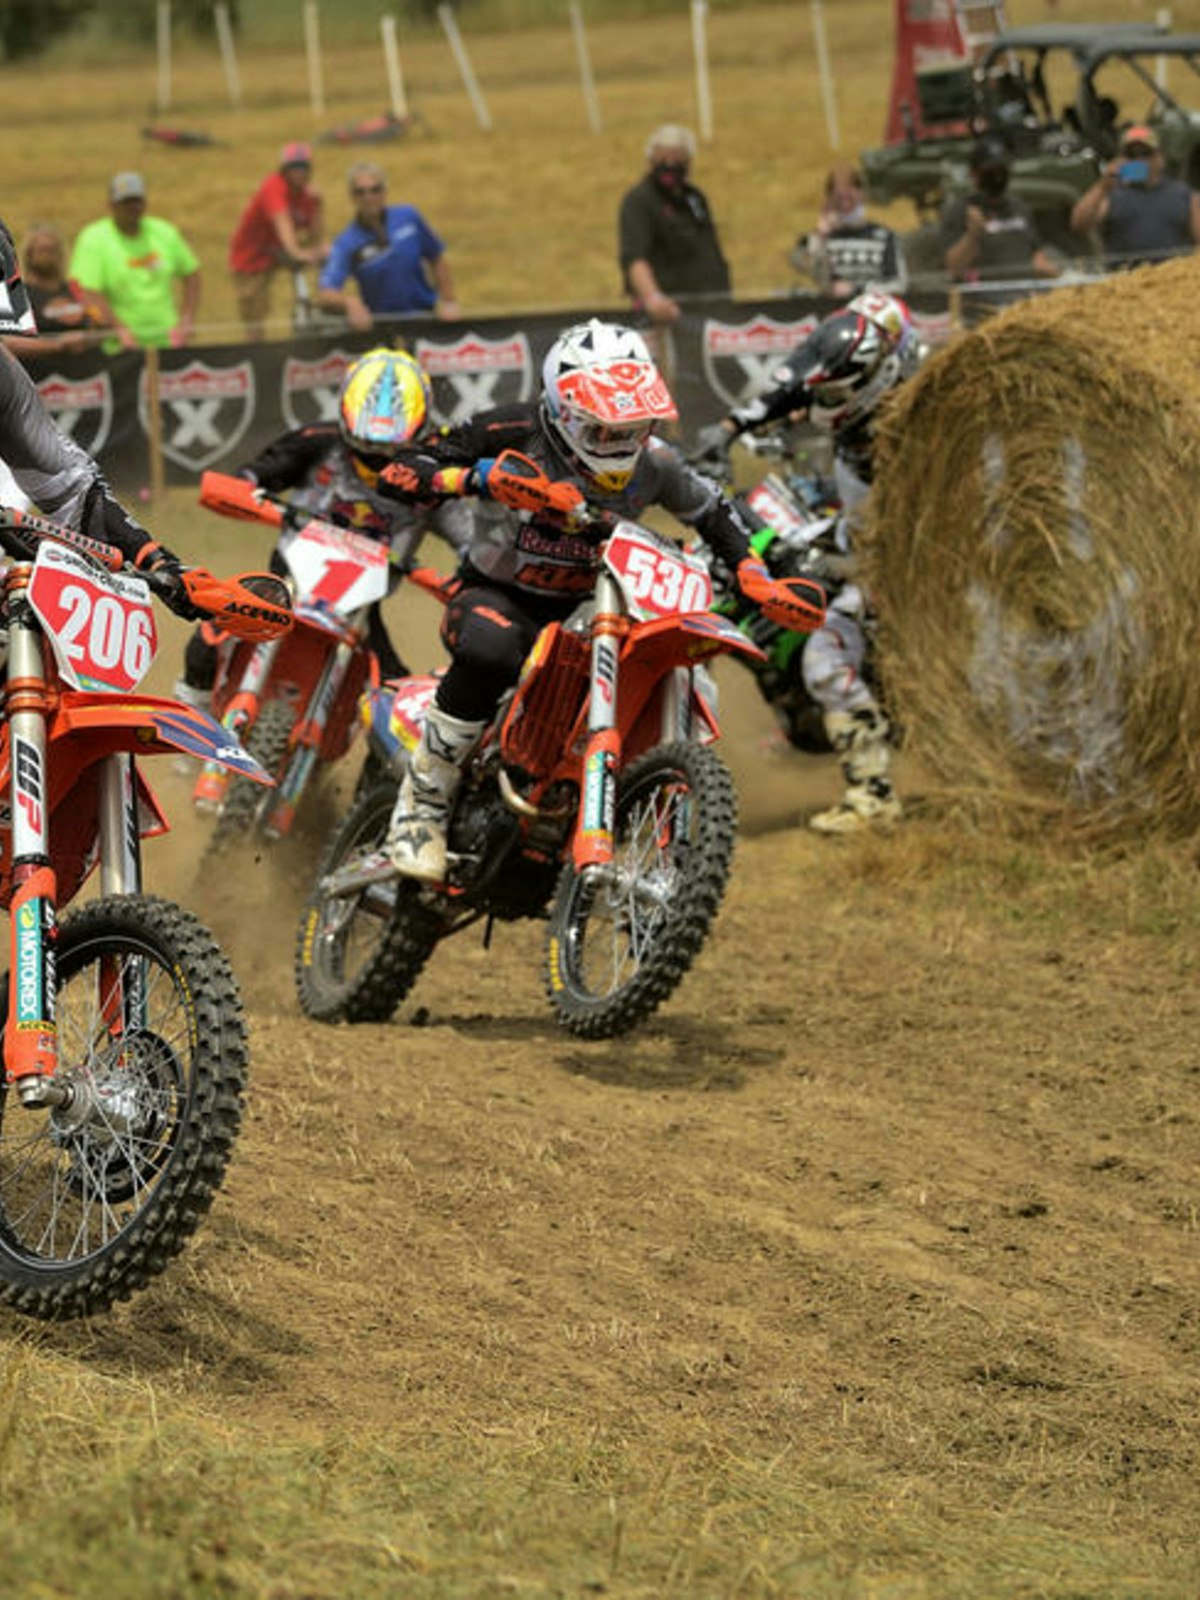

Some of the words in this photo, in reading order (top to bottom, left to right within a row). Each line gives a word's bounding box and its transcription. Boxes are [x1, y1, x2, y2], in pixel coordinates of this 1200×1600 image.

[170, 399, 224, 448] X
[450, 374, 500, 422] X
[311, 559, 367, 607] 1
[623, 546, 708, 612] 530
[57, 584, 152, 681] 206
[20, 930, 38, 1018] MOTOREX
